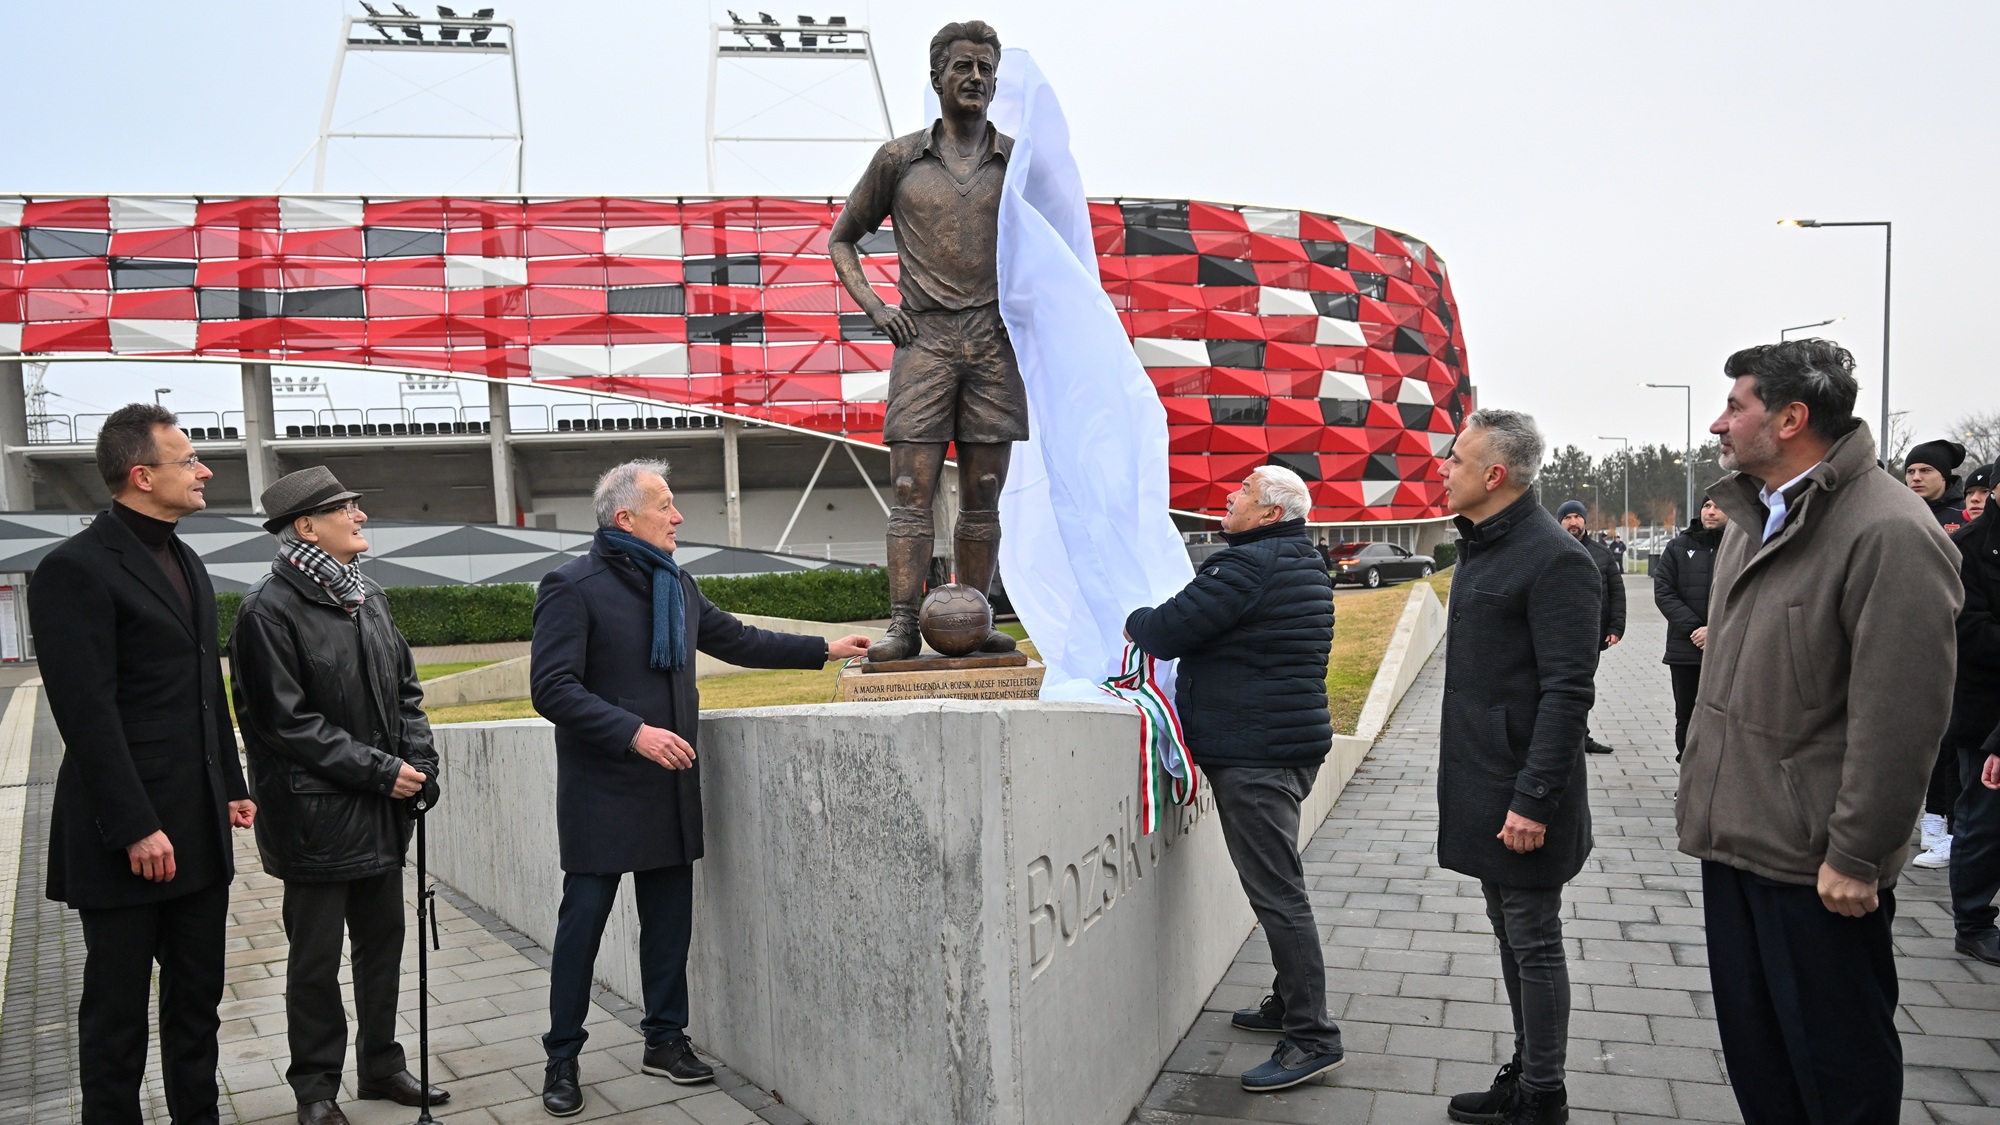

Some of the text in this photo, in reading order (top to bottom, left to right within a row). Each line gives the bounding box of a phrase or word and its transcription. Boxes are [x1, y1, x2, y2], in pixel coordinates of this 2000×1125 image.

[853, 677, 1038, 694] A MAGYAR FUTBALL LEGENDÁJA BOZSIK JÓZSEF TISZTELETÉRE
